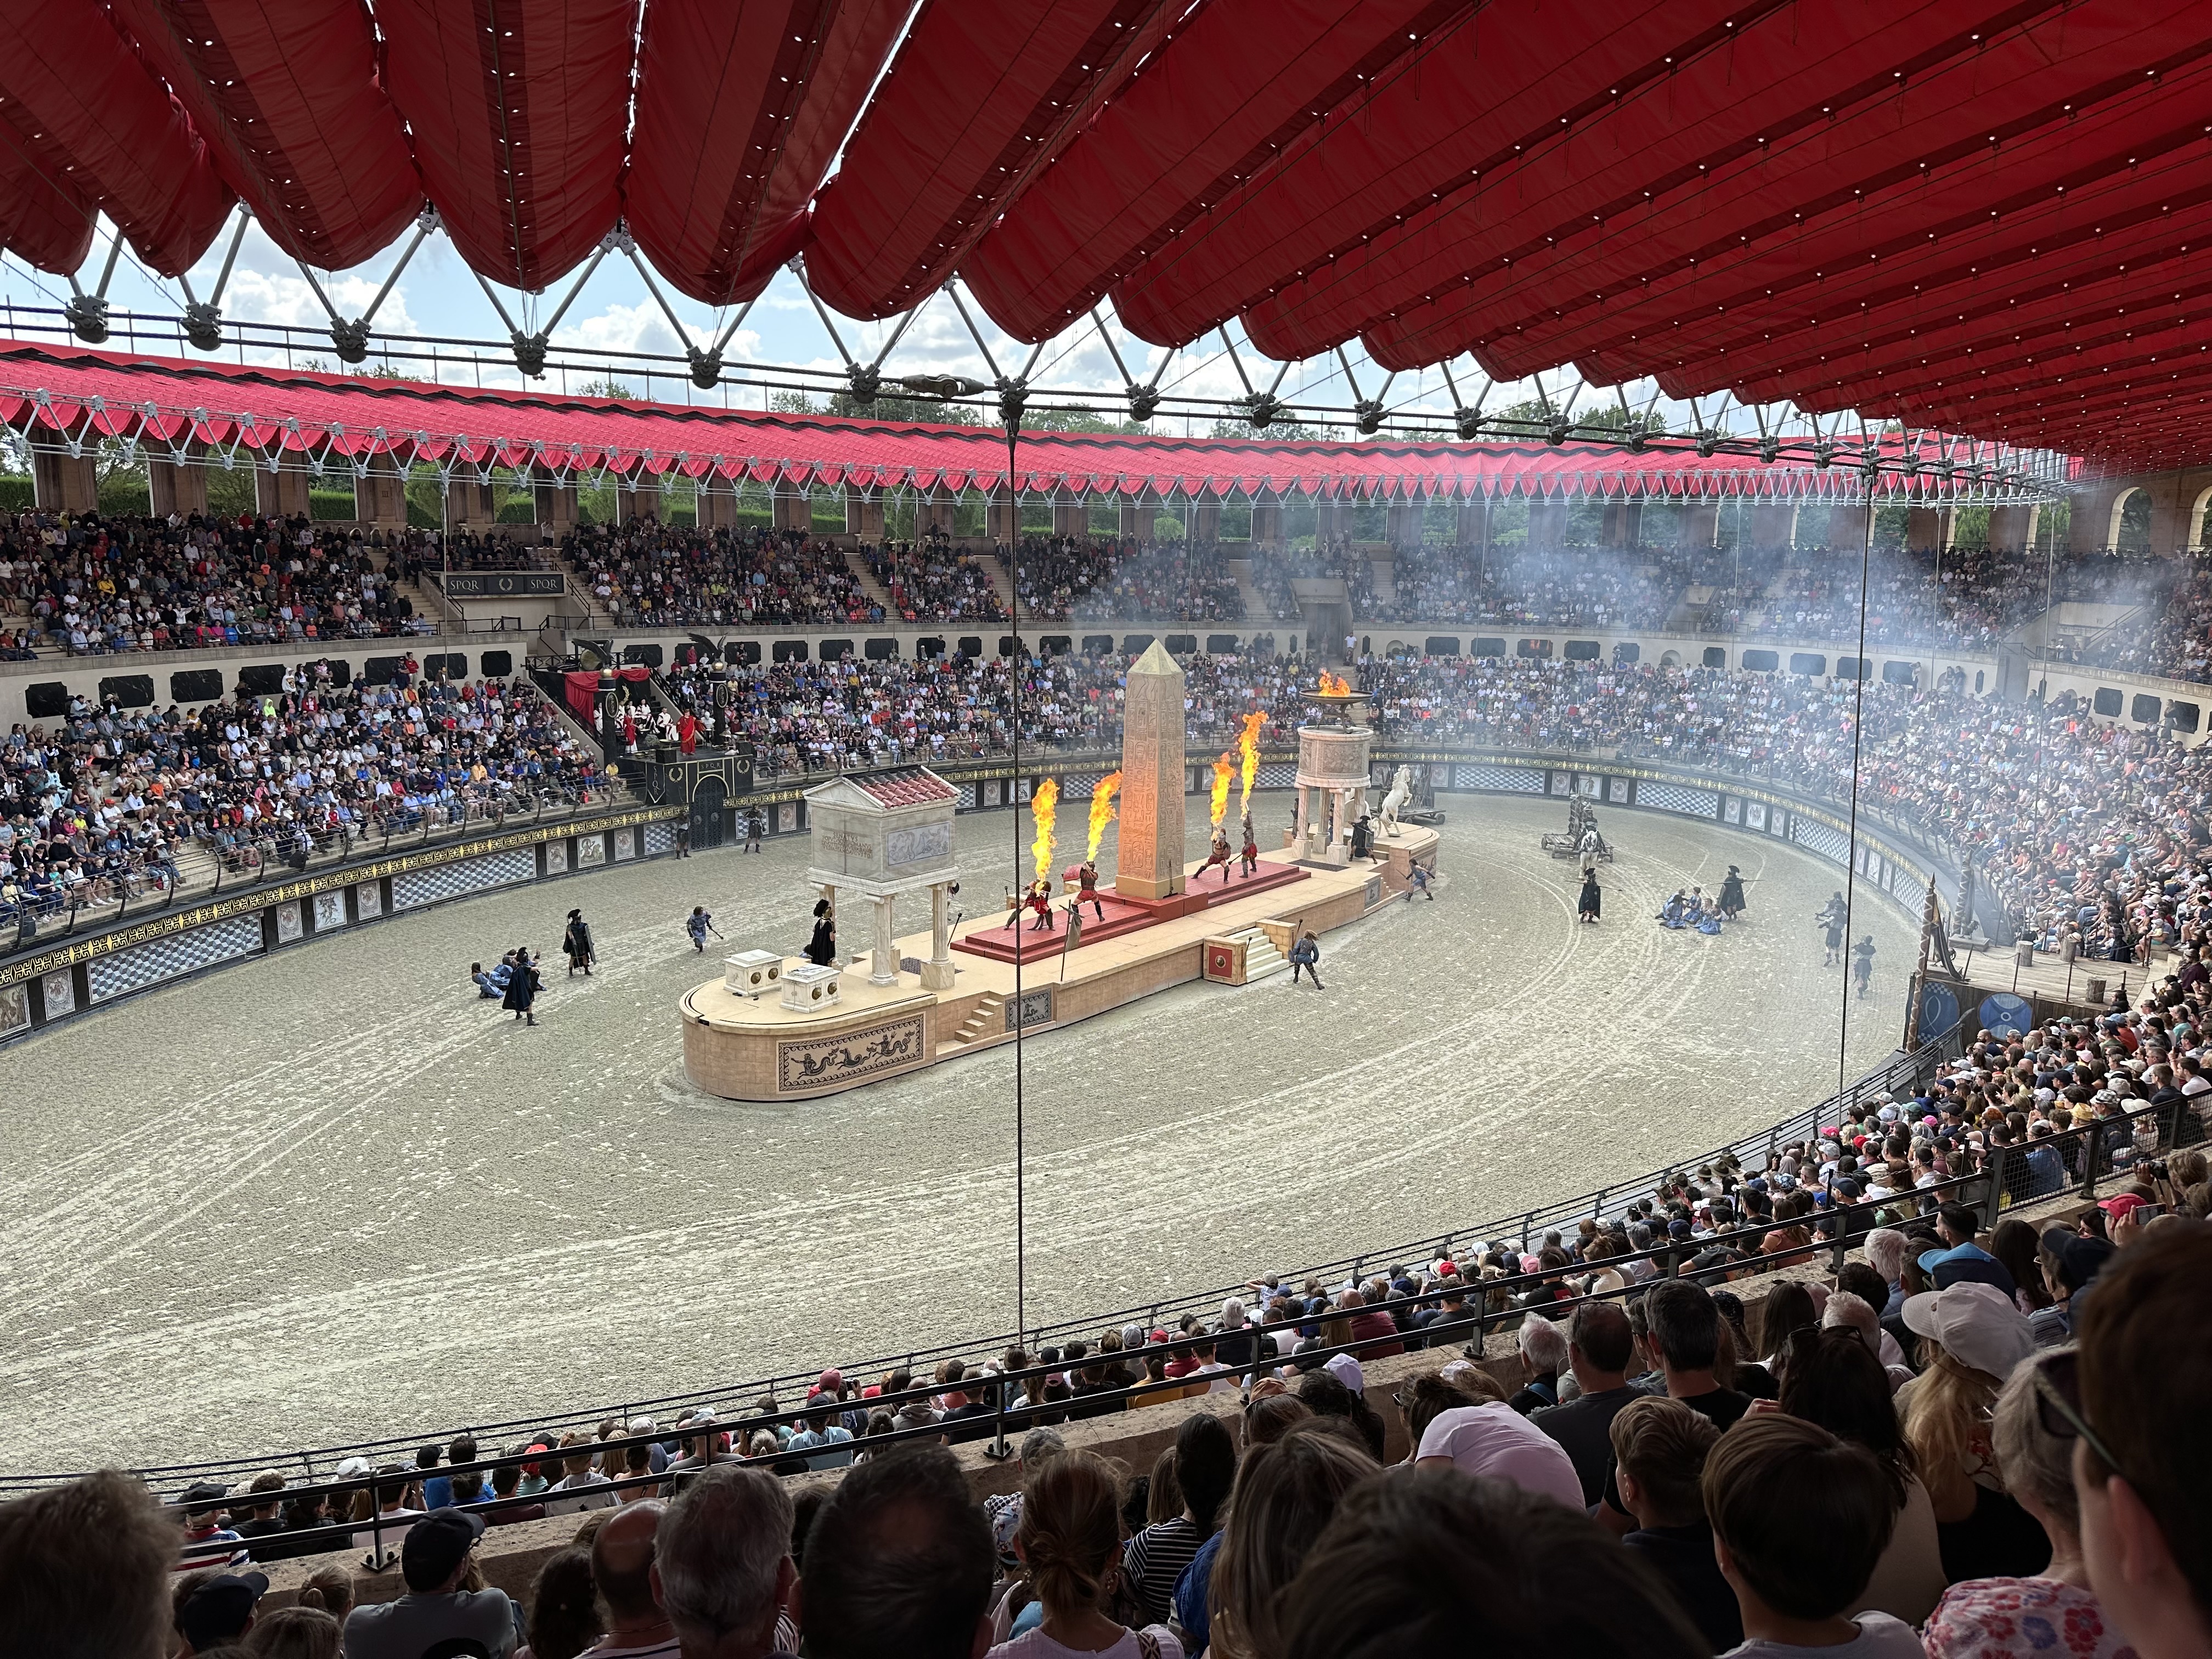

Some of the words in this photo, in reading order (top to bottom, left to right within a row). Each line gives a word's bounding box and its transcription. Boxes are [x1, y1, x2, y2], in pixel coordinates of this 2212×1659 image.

[450, 580, 479, 592] SPQR
[531, 579, 557, 590] SPQR
[652, 765, 661, 795] SPQR
